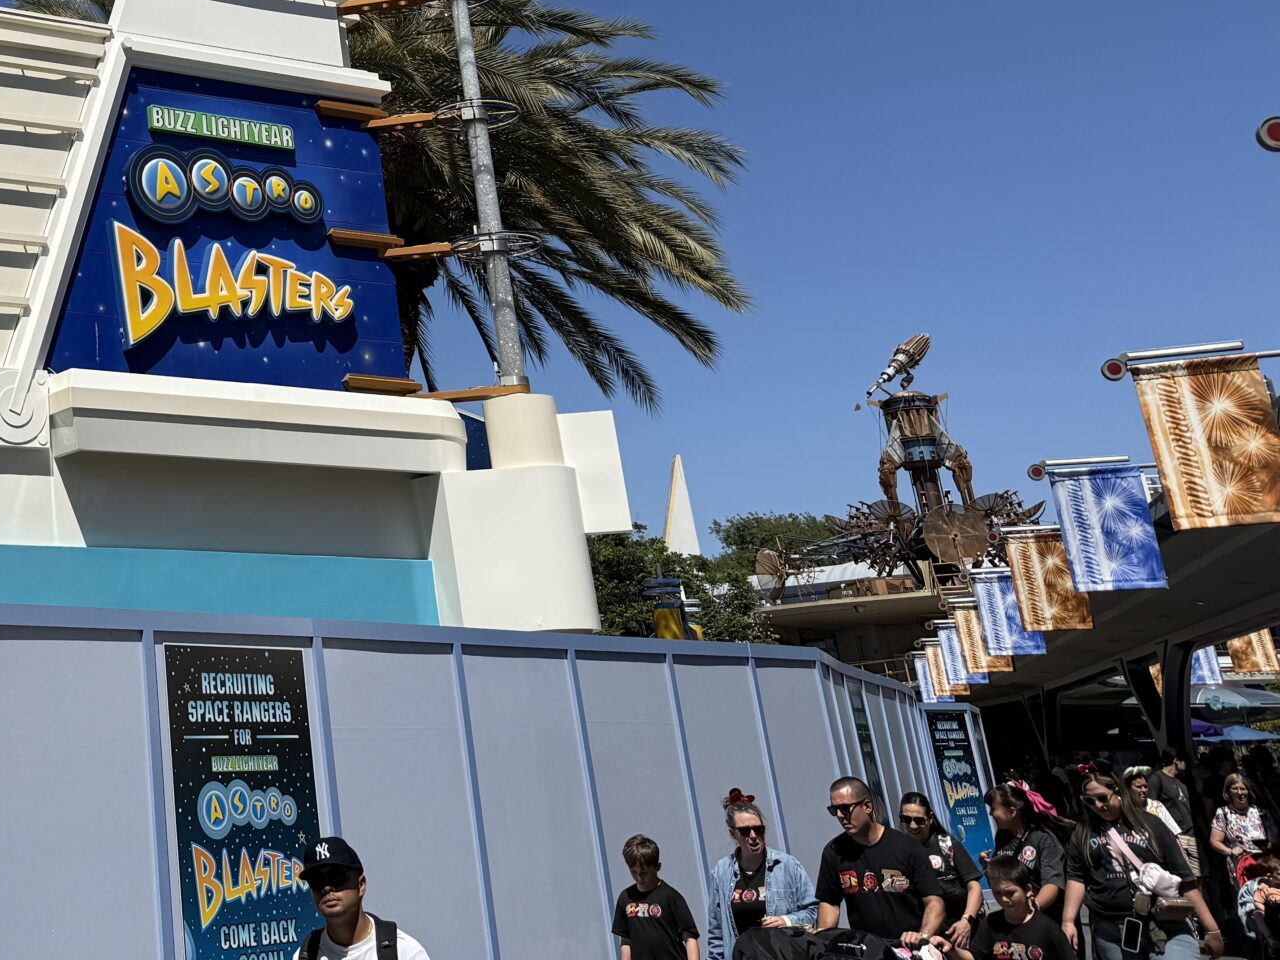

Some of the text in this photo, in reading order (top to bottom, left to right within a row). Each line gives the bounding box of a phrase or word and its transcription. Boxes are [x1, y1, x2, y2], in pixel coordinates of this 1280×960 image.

[152, 106, 294, 148] BUZZ LIGHTYEAR
[150, 158, 315, 209] ASTRO
[111, 219, 356, 350] BLASTERS
[201, 672, 275, 696] RECRUITING
[187, 700, 292, 723] SPACE RANGERS
[233, 728, 253, 746] FOR
[211, 755, 279, 772] BUZZ LIGHTYEAR
[206, 791, 293, 827] ASTRO
[315, 842, 330, 860] NY
[220, 918, 298, 950] COME BACK
